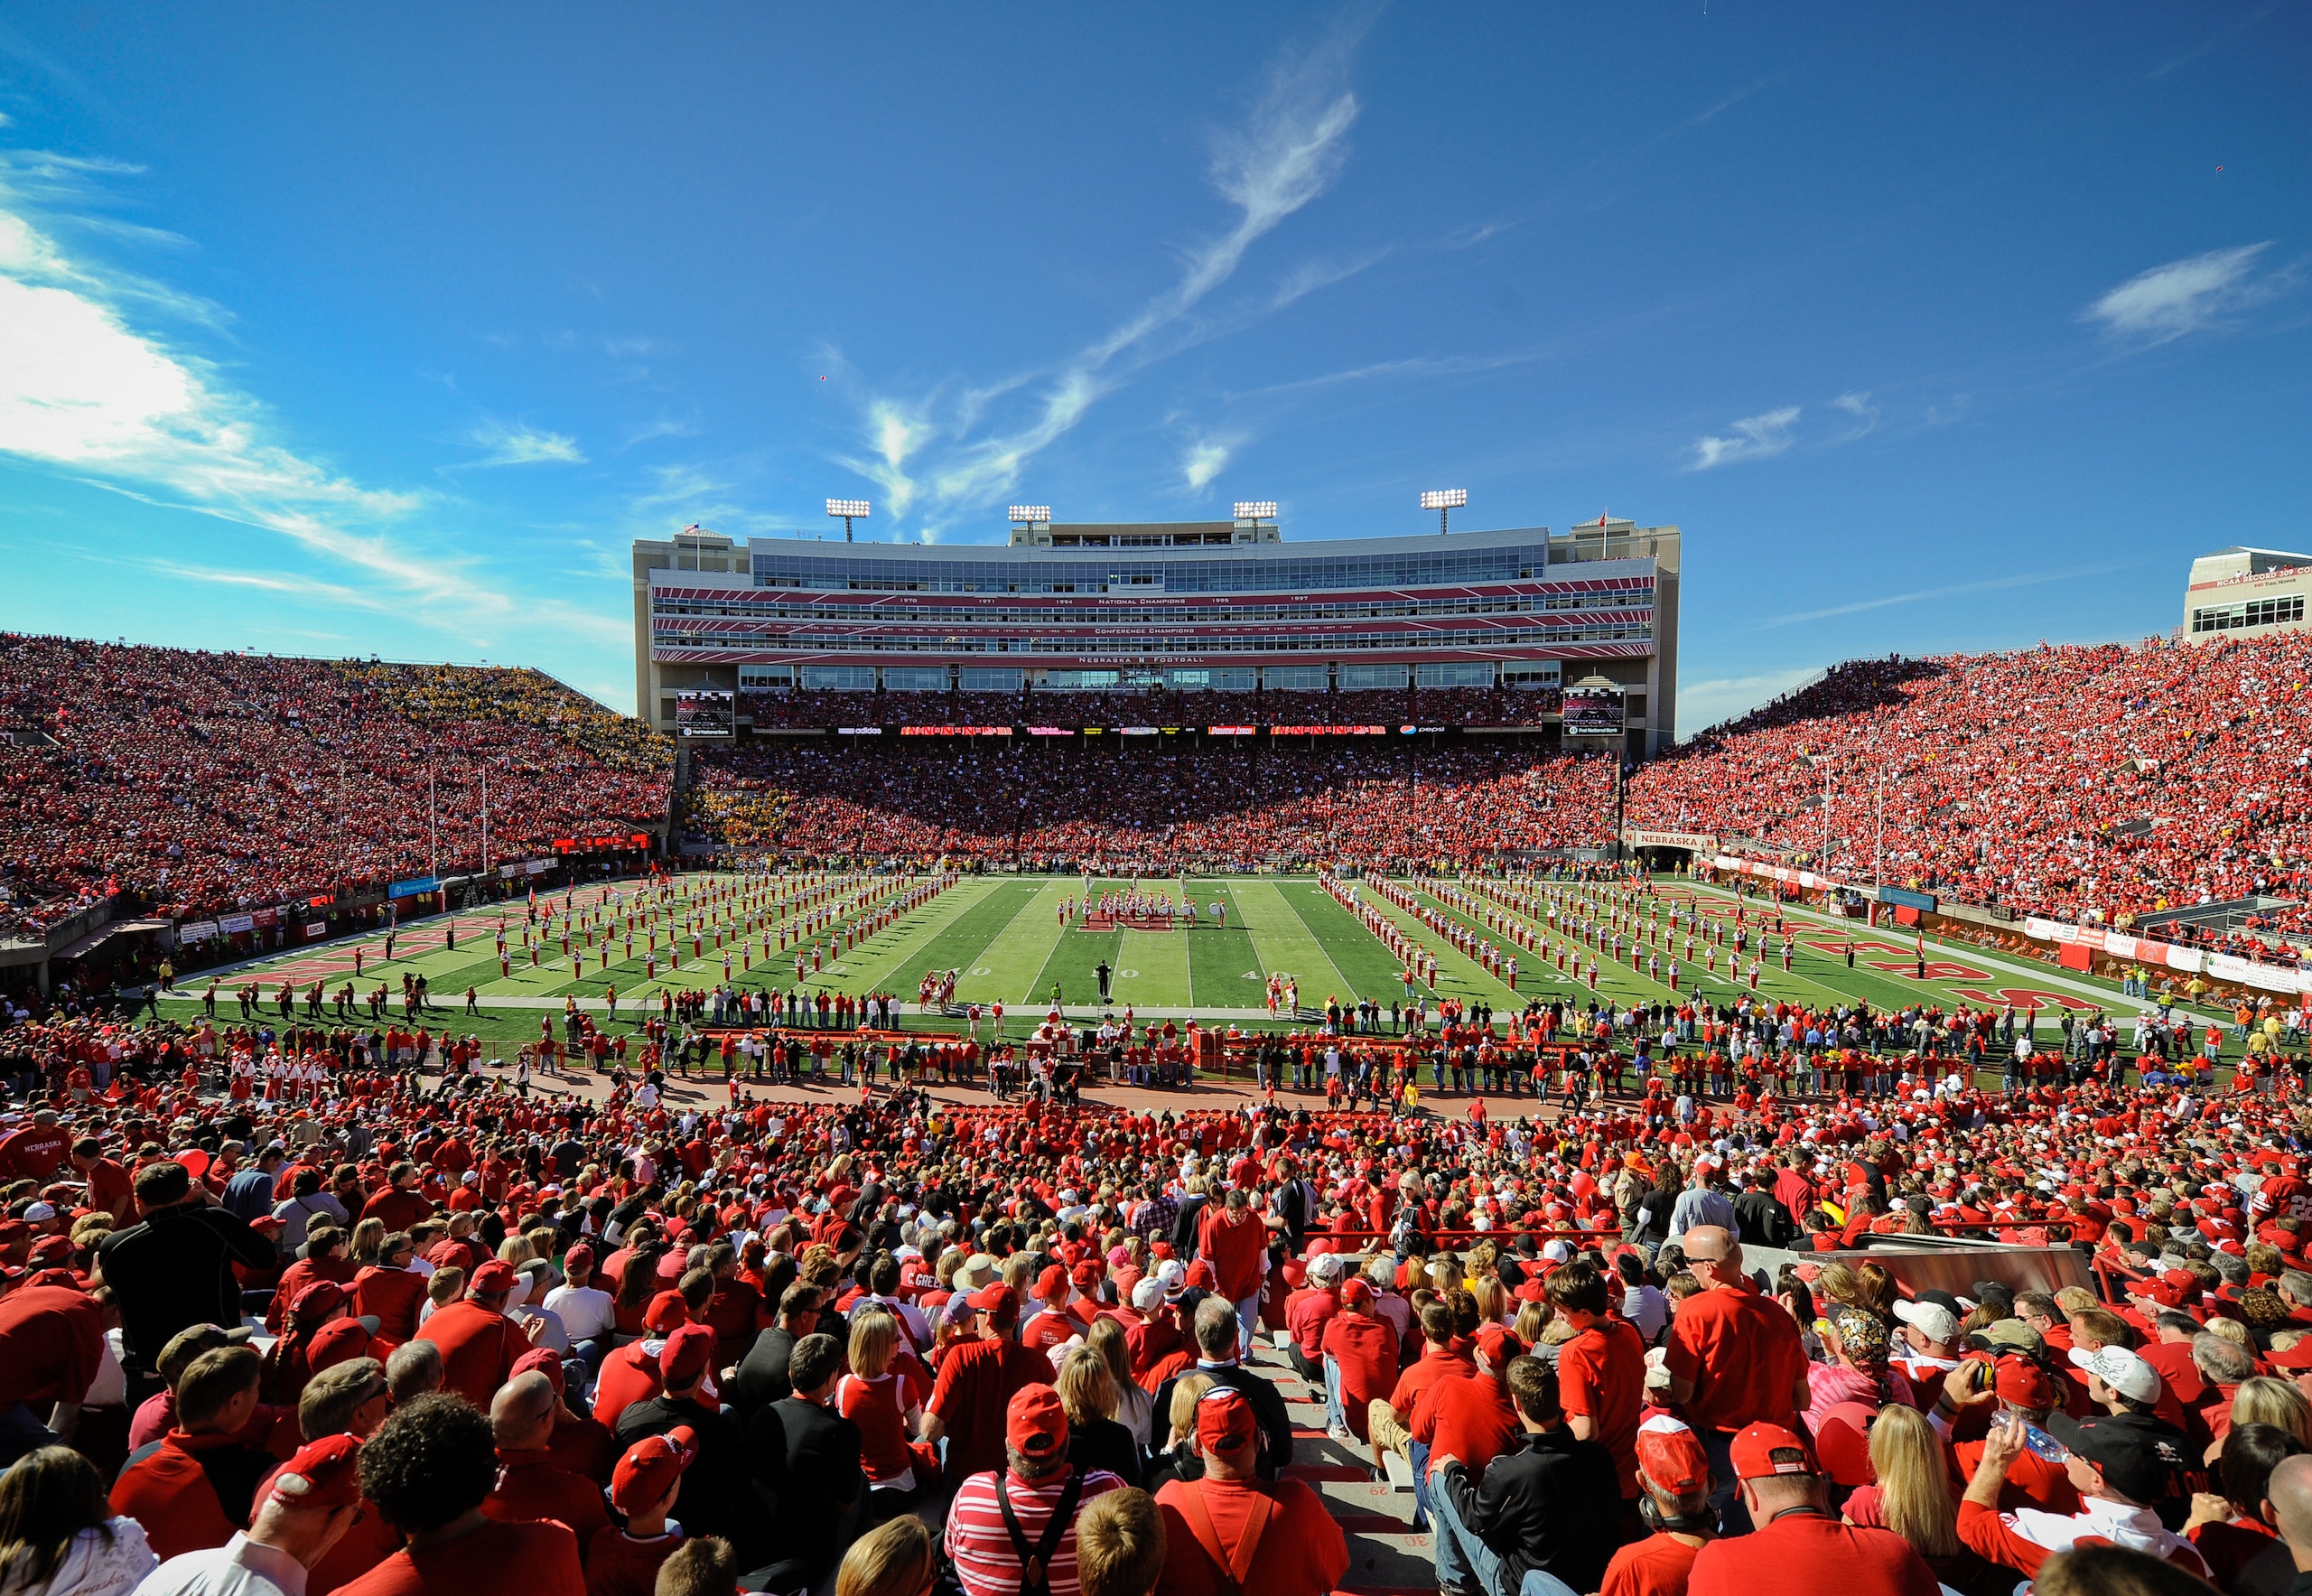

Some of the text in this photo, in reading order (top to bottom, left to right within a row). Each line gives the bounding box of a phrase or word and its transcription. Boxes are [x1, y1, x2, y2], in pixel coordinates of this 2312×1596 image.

[2217, 579, 2240, 587] NCAA
[2243, 572, 2277, 583] RECORD
[2279, 569, 2294, 577] 309
[1641, 835, 1698, 845] NEBRASKA
[1706, 839, 1714, 847] N
[1179, 1129, 1189, 1140] 12
[24, 1140, 61, 1153] NEBRASKA
[743, 1155, 750, 1167] 9
[908, 1273, 942, 1289] C.GREE
[1369, 1486, 1388, 1496] 29
[1403, 1535, 1429, 1547] 30
